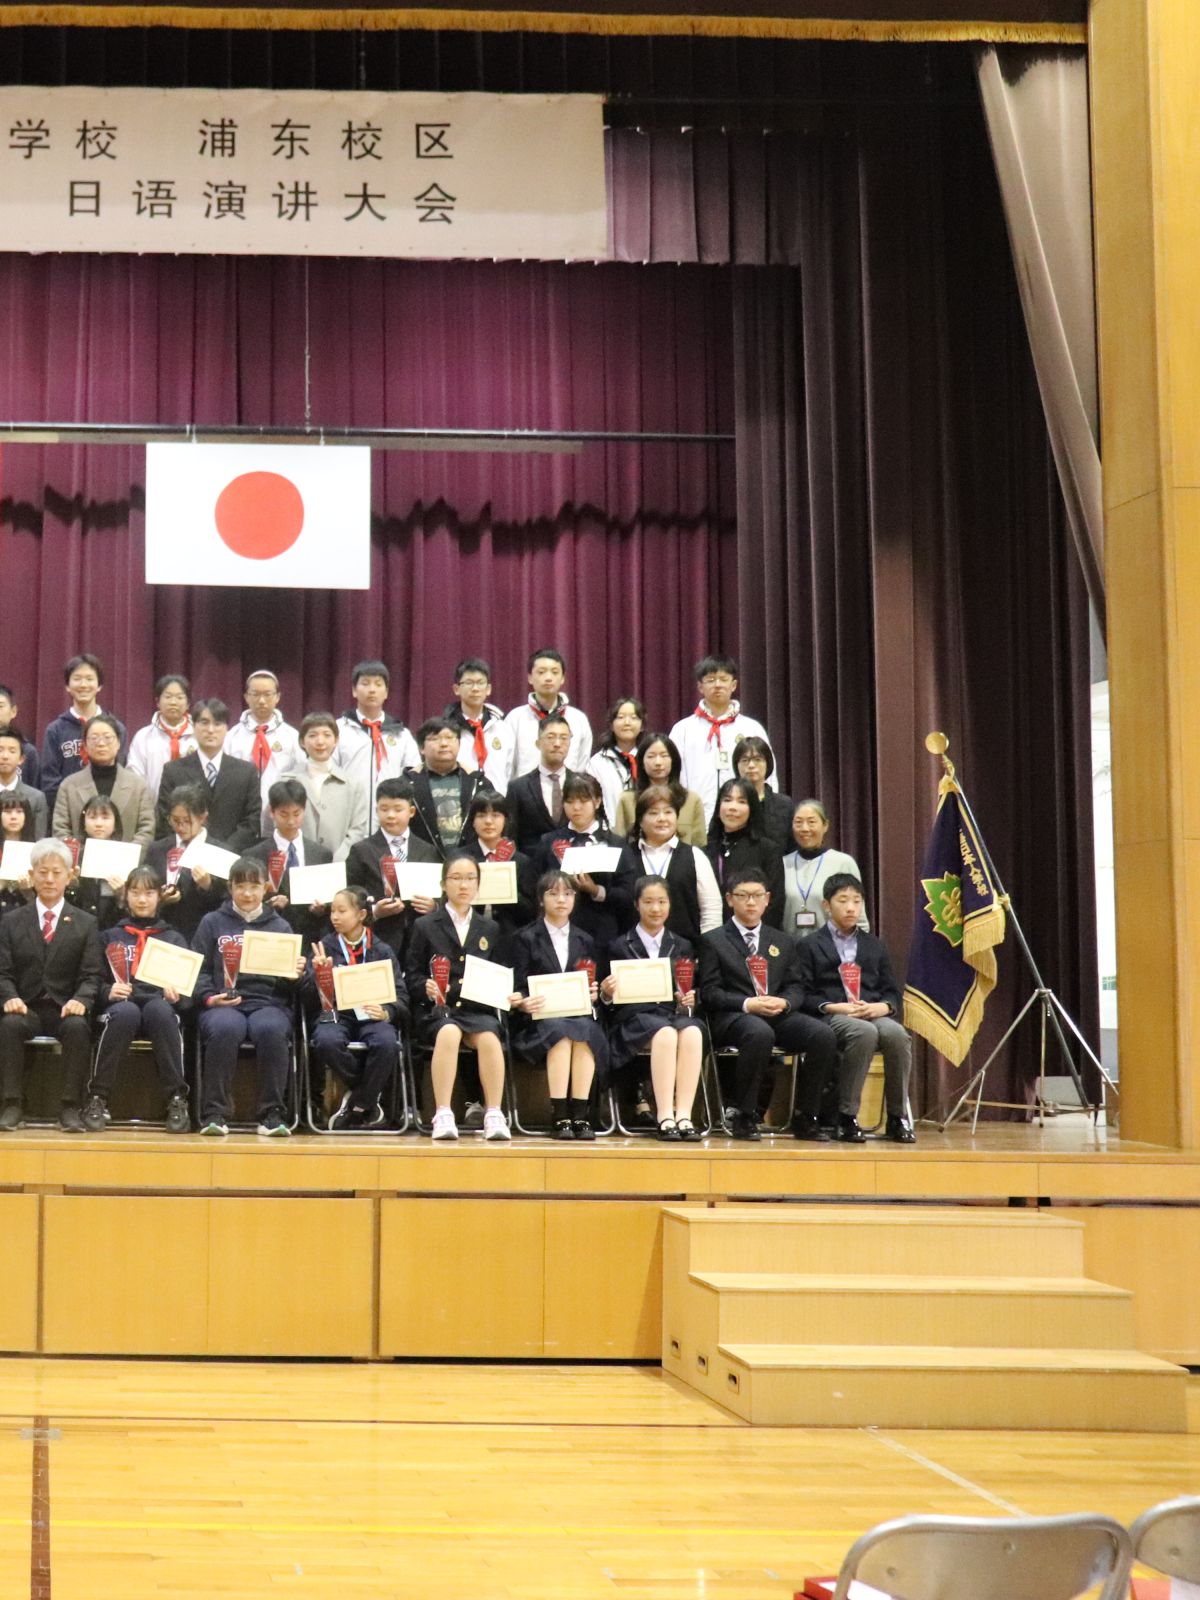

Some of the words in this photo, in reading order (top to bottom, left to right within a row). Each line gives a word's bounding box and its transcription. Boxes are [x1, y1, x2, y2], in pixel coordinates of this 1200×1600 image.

[198, 117, 454, 161] 浦东校区
[68, 179, 458, 225] 日语演讲大会
